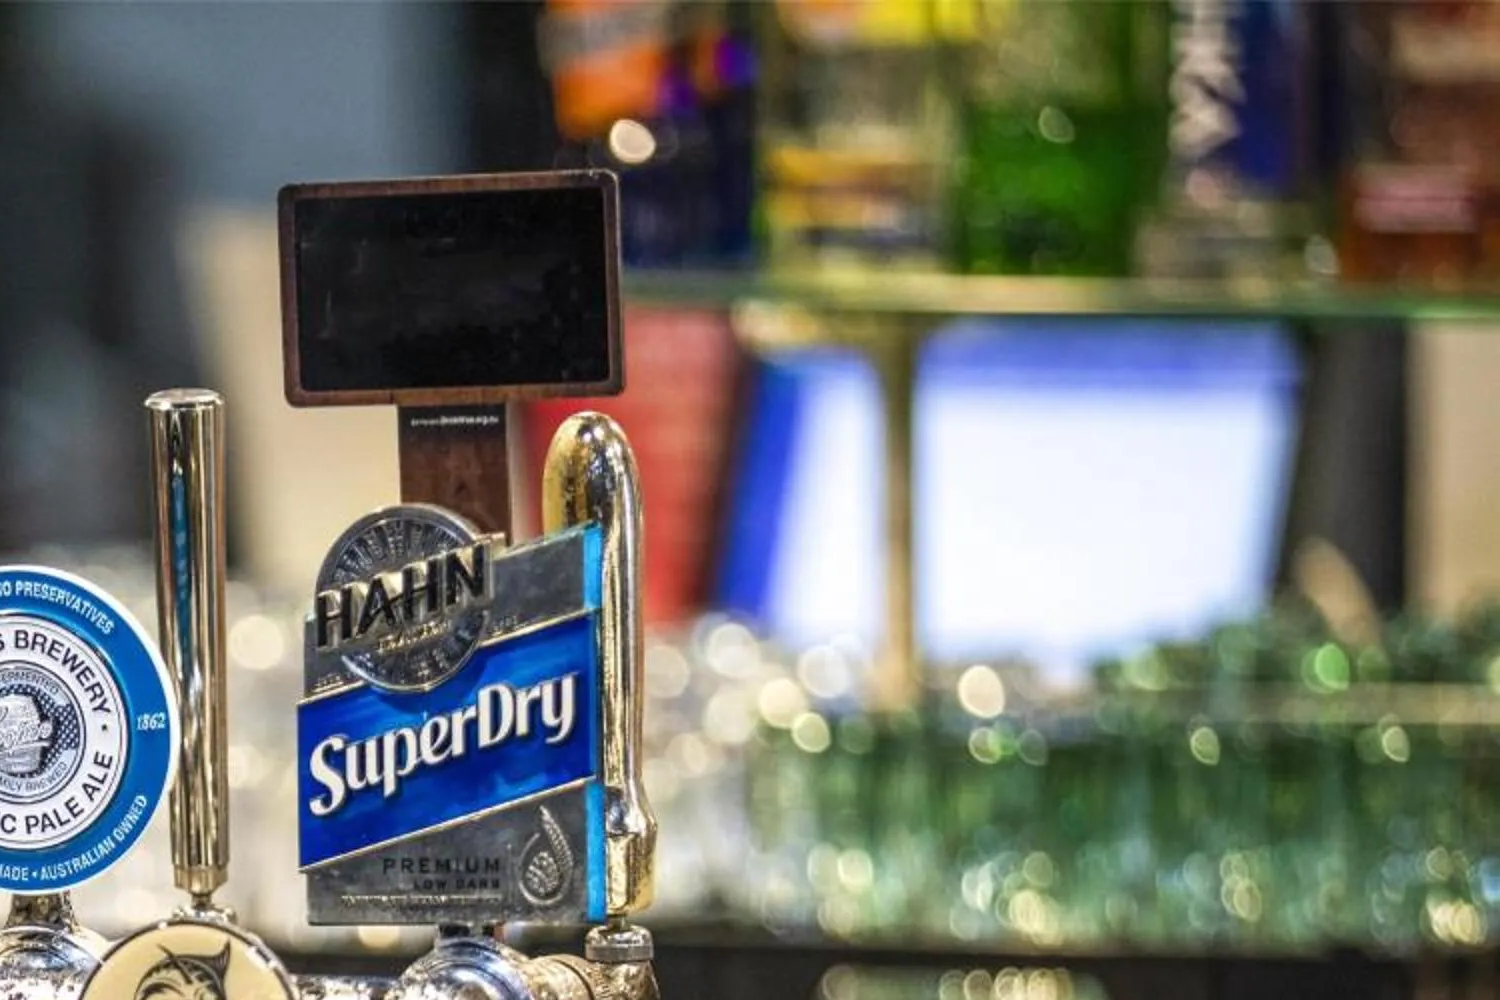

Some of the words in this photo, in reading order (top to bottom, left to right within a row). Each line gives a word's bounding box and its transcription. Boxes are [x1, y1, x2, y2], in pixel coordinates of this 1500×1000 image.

[15, 579, 116, 636] PRESERVATIVES
[315, 541, 488, 648] HAHN
[13, 628, 112, 715] BREWERY
[308, 671, 580, 817] SuperDry
[24, 796, 86, 835] PALE
[87, 750, 114, 803] ALE
[40, 837, 117, 882] AUSTRALIAN
[113, 795, 149, 843] OWNED
[382, 856, 500, 875] PREMIUM
